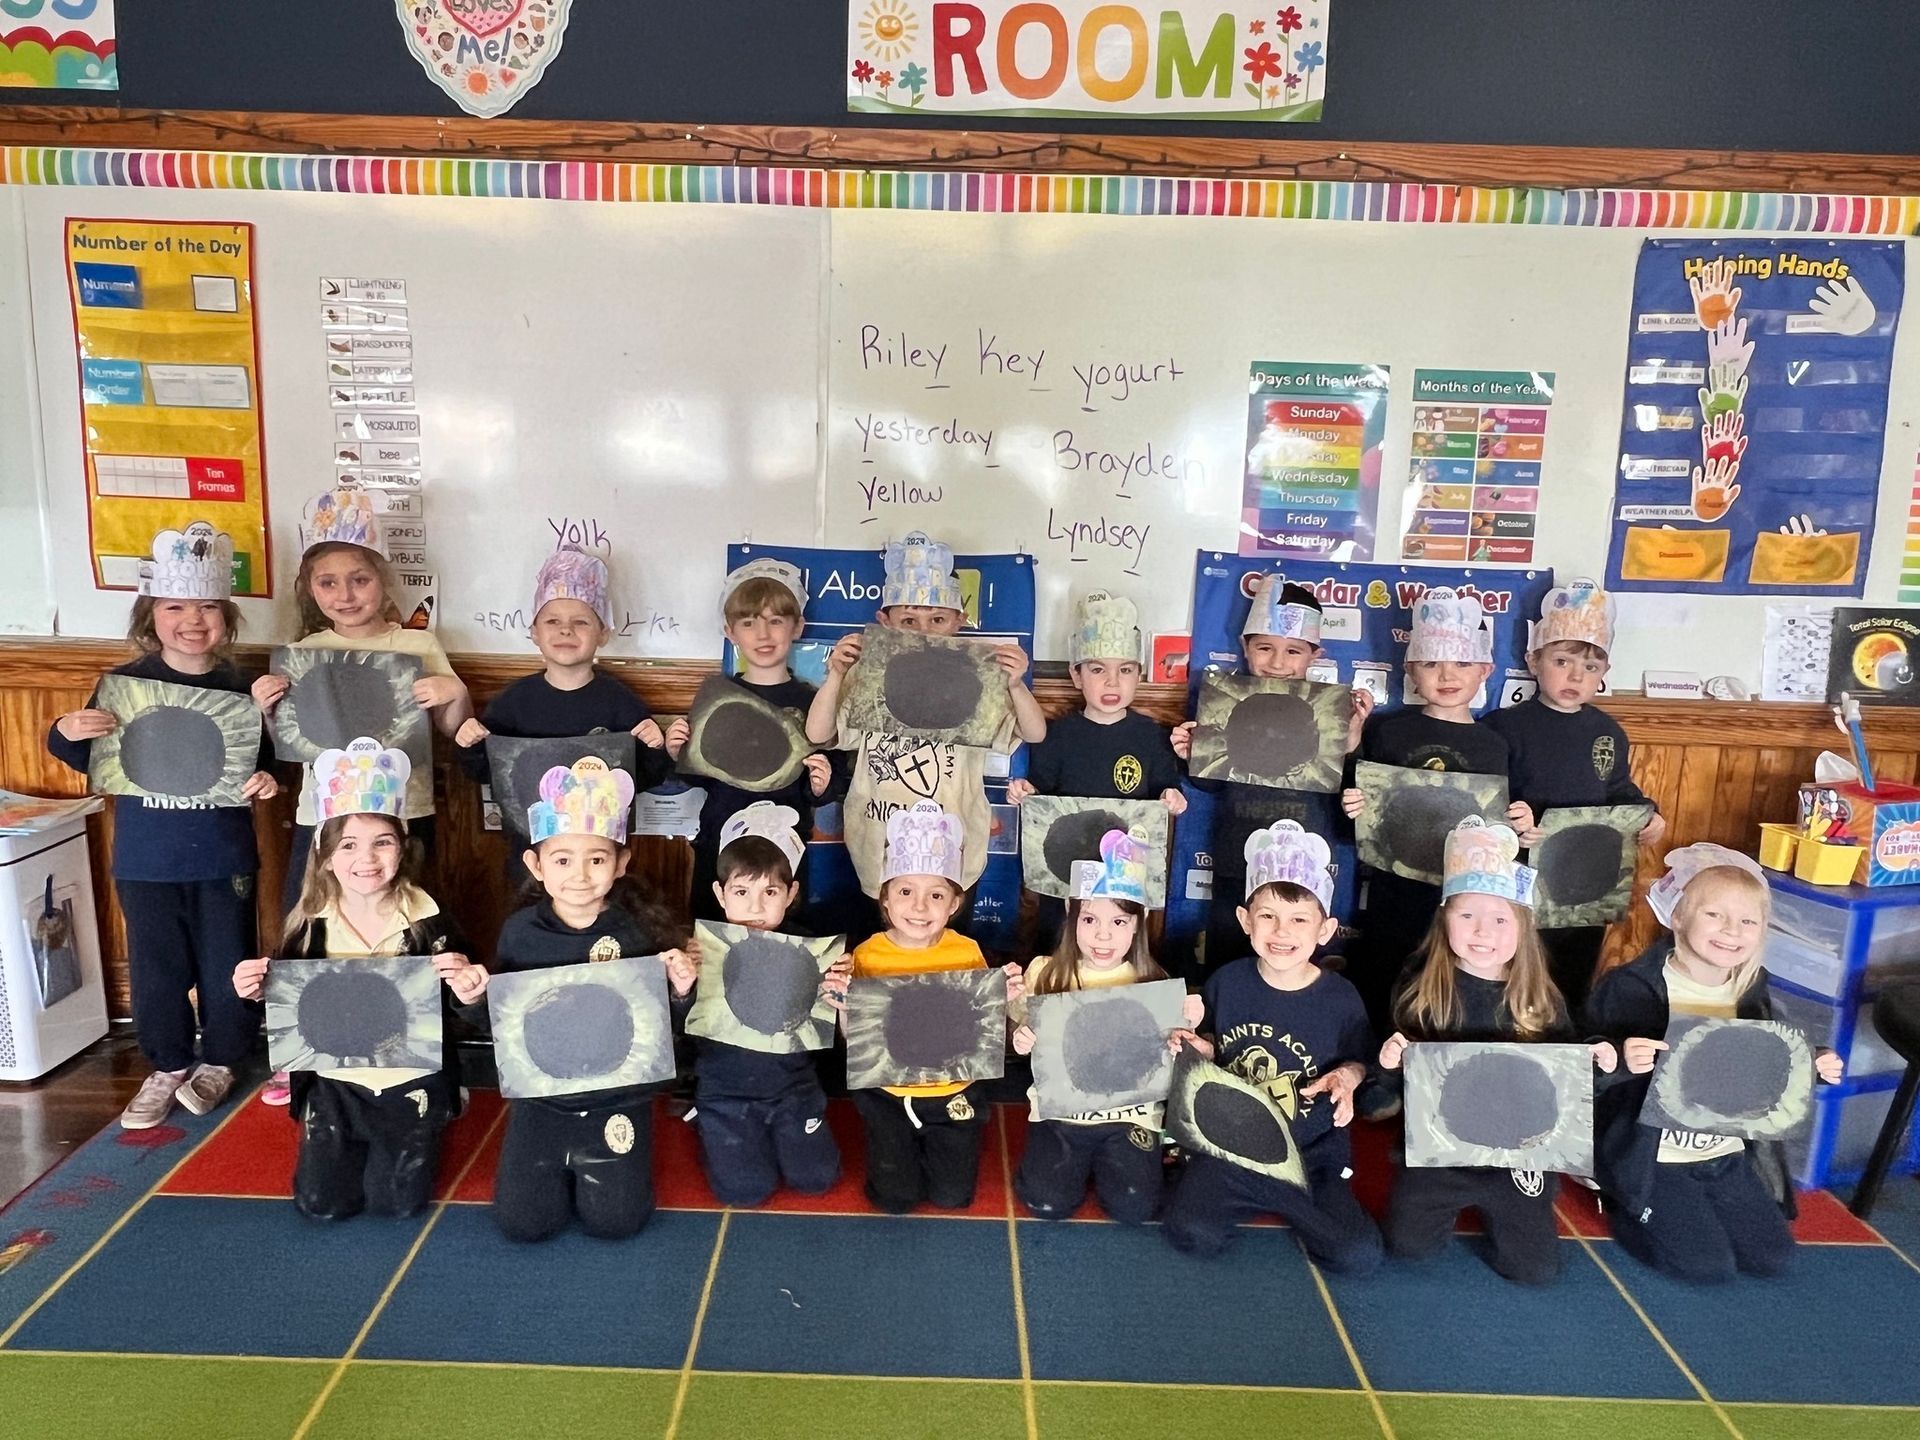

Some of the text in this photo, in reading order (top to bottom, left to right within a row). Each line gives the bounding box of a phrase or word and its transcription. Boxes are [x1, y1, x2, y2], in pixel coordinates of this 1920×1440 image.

[456, 27, 511, 65] Me!
[933, 3, 1235, 102] ROOM
[73, 234, 241, 258] Number of the Day
[1778, 254, 1850, 280] Hands
[861, 325, 1184, 403] Riley Key yogurt
[1255, 372, 1386, 388] Days of the Wee
[1421, 380, 1468, 393] Months
[1472, 381, 1486, 394] of
[1490, 383, 1511, 394] the
[97, 383, 131, 396] Order
[1291, 406, 1340, 421] Sunday
[379, 449, 400, 460] bee
[1053, 430, 1205, 488] Brayden
[206, 468, 224, 479] Ten
[1272, 470, 1349, 486] Wednesday
[197, 481, 236, 493] Frames
[387, 500, 411, 511] OTH
[1279, 492, 1339, 507] Thursday
[1668, 508, 1693, 516] HELP
[1287, 513, 1328, 528] Friday
[1048, 508, 1150, 569] Lyndsey
[1276, 533, 1335, 548] Saturday
[400, 573, 433, 586] TERFLY
[818, 569, 881, 600] Abo
[1240, 571, 1362, 607] Cdar
[1364, 580, 1391, 609] &
[1323, 617, 1346, 629] April
[1848, 617, 1920, 636] Total Solar Eclipse
[1511, 686, 1524, 702] 6
[1647, 681, 1700, 692] Wednesday
[578, 762, 602, 770] 2024
[916, 804, 938, 812] 2024
[974, 896, 1004, 907] etter
